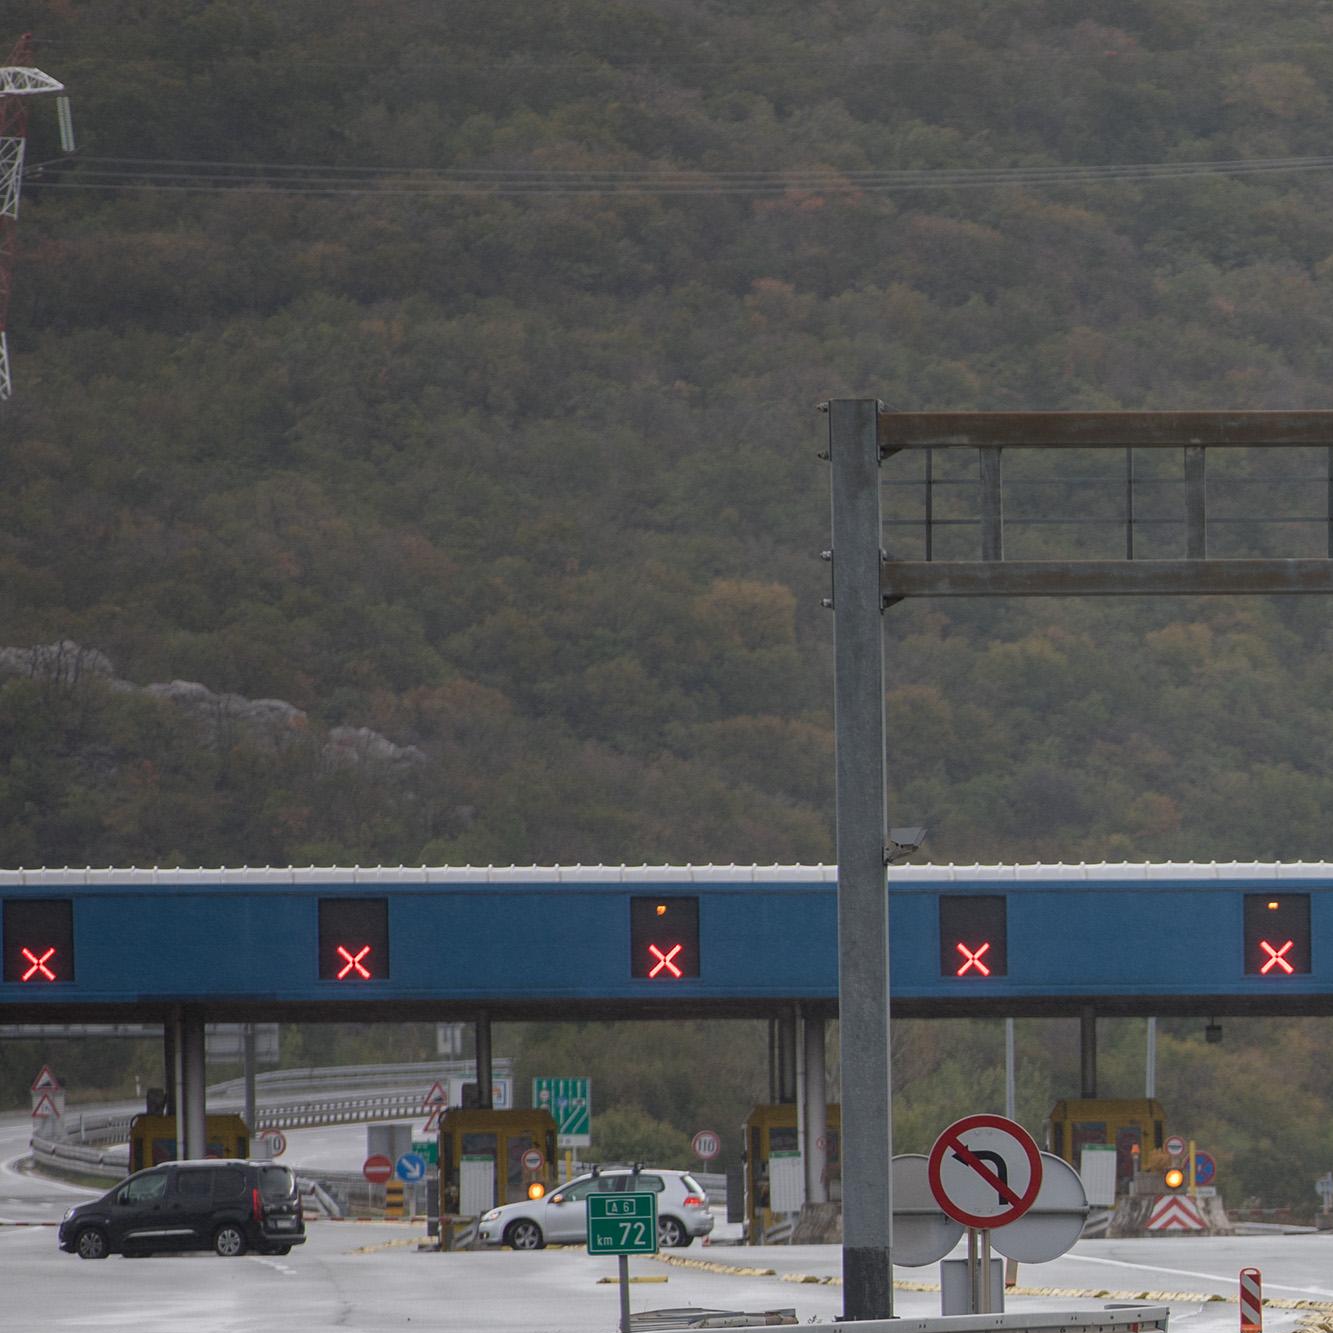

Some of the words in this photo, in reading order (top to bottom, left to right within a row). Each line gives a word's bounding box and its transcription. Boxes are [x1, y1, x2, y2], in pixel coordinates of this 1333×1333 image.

[611, 1202, 618, 1212] A
[623, 1202, 630, 1212] 6
[597, 1234, 613, 1246] km
[619, 1222, 646, 1245] 72
